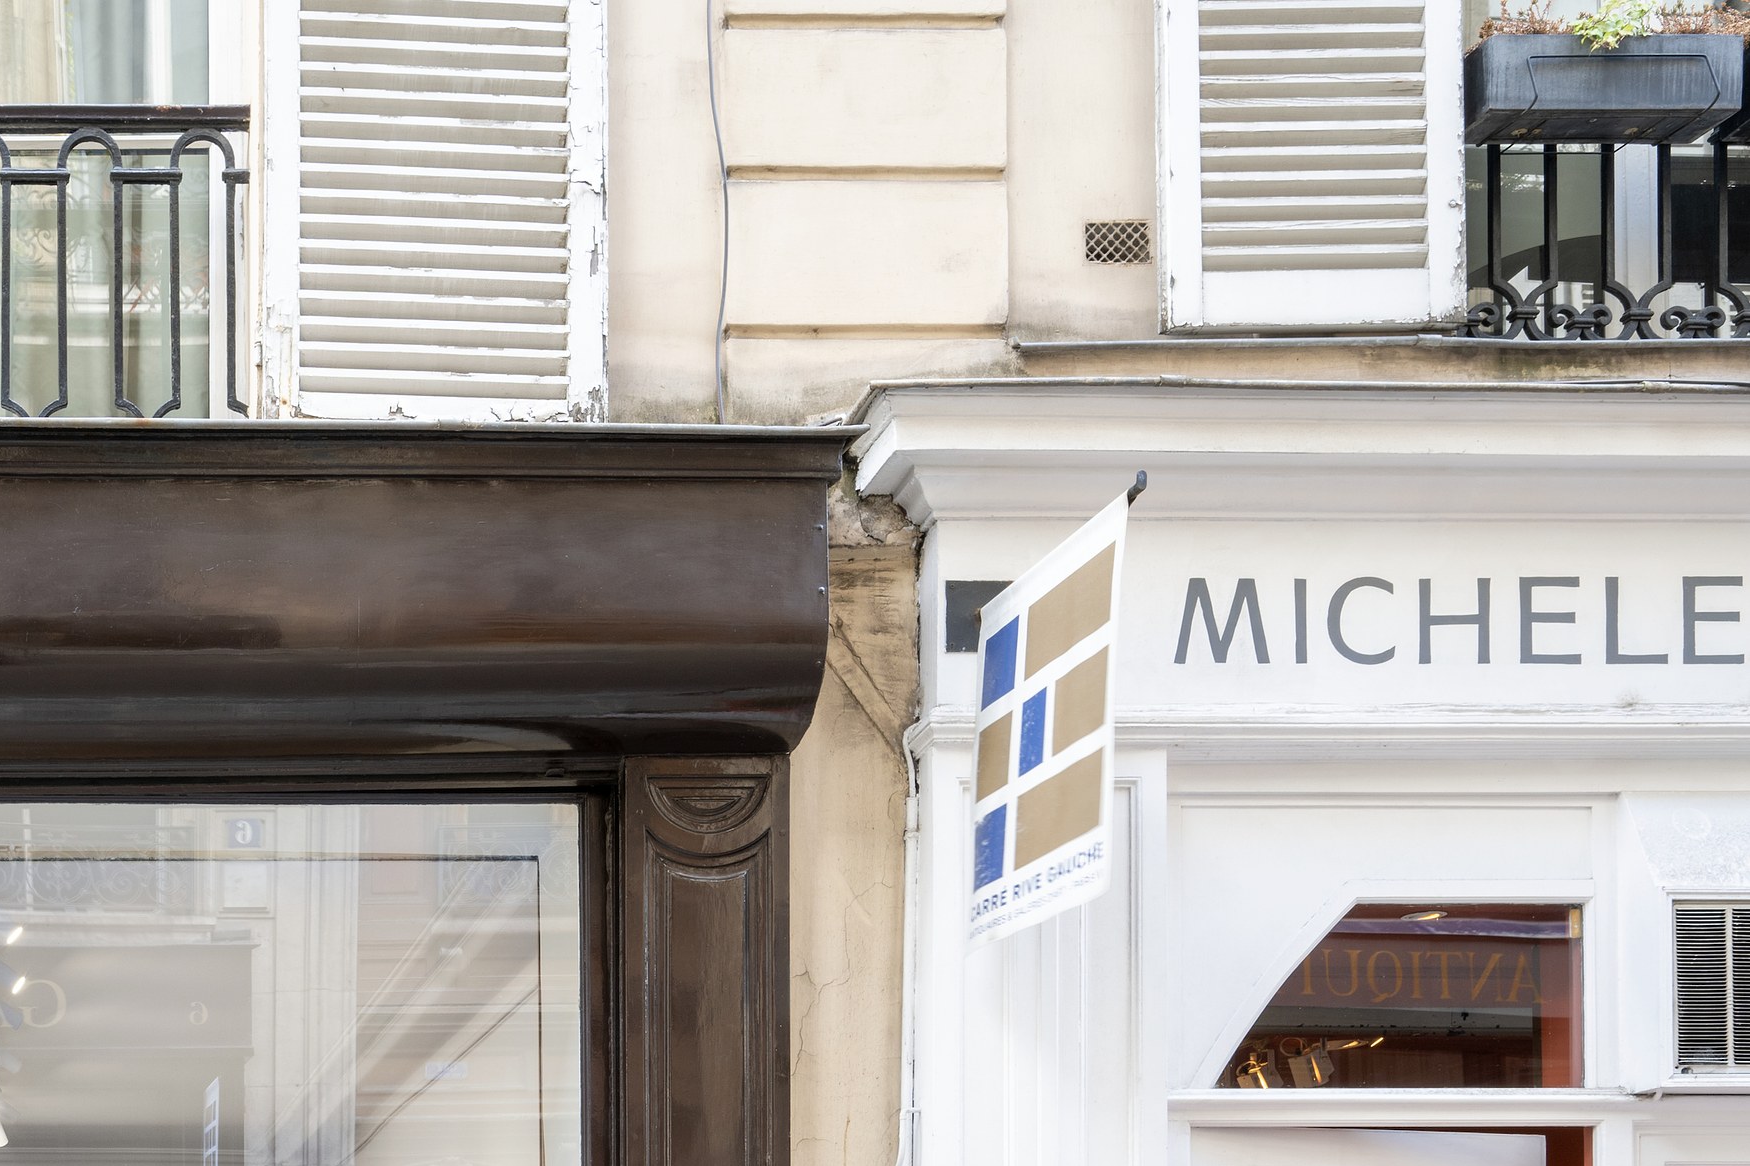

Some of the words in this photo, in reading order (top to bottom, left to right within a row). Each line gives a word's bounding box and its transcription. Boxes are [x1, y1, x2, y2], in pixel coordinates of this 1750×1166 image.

[1173, 576, 1745, 665] MICHELE
[970, 886, 1008, 923] CARRÉ
[1012, 872, 1042, 902] RIVE
[1047, 841, 1104, 883] GAUCHE
